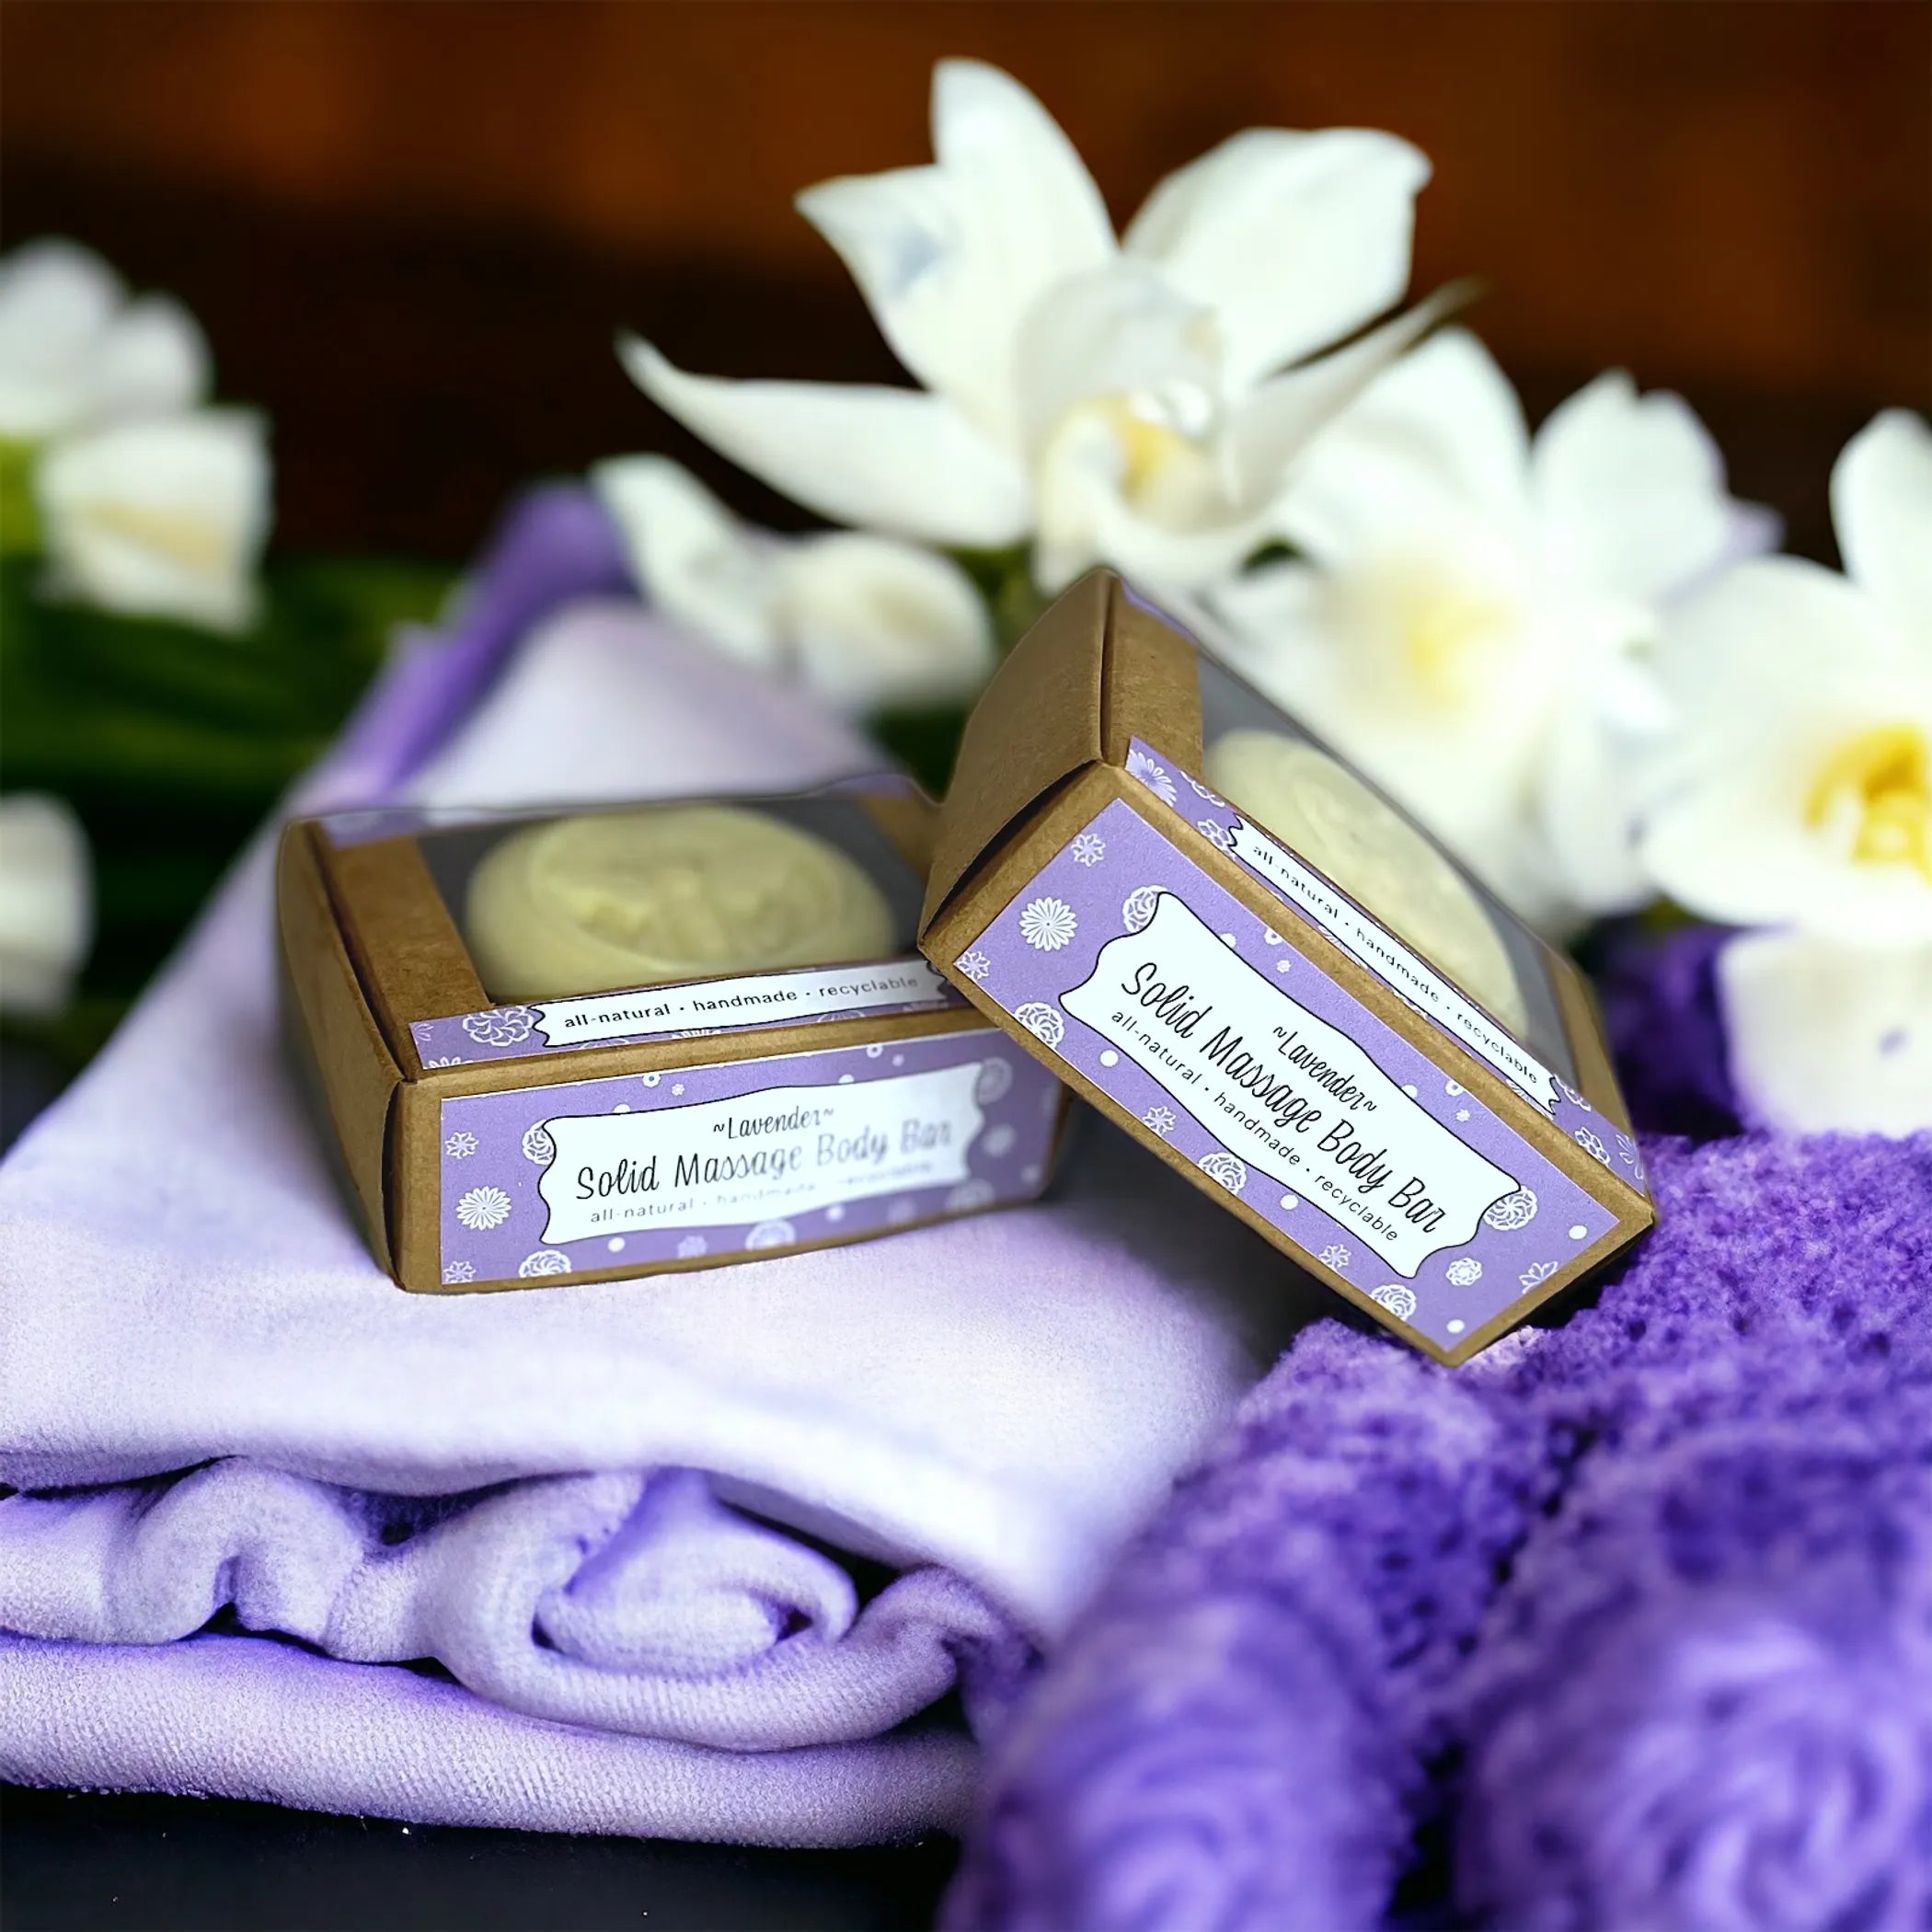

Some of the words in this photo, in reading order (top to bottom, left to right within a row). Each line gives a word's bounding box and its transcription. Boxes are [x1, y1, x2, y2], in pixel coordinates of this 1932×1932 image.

[564, 1004, 670, 1028] all-natural
[694, 990, 798, 1013] handmade
[819, 977, 918, 999] recyclable
[1253, 846, 1339, 918] all-natural
[1357, 928, 1439, 1002] handmade
[1457, 1012, 1537, 1084] recyclable
[576, 1156, 660, 1200] Solid
[674, 1147, 802, 1189] Massage
[817, 1124, 888, 1167] Body
[1111, 1012, 1199, 1085] all-natural
[1215, 1091, 1300, 1166] handmade
[1315, 1174, 1397, 1241] recyclable
[1121, 962, 1213, 1039] Solid
[1200, 1027, 1321, 1133] Massage
[1317, 1120, 1390, 1193] Body
[1388, 1178, 1445, 1233] Bar
[591, 1199, 694, 1223] all-natural
